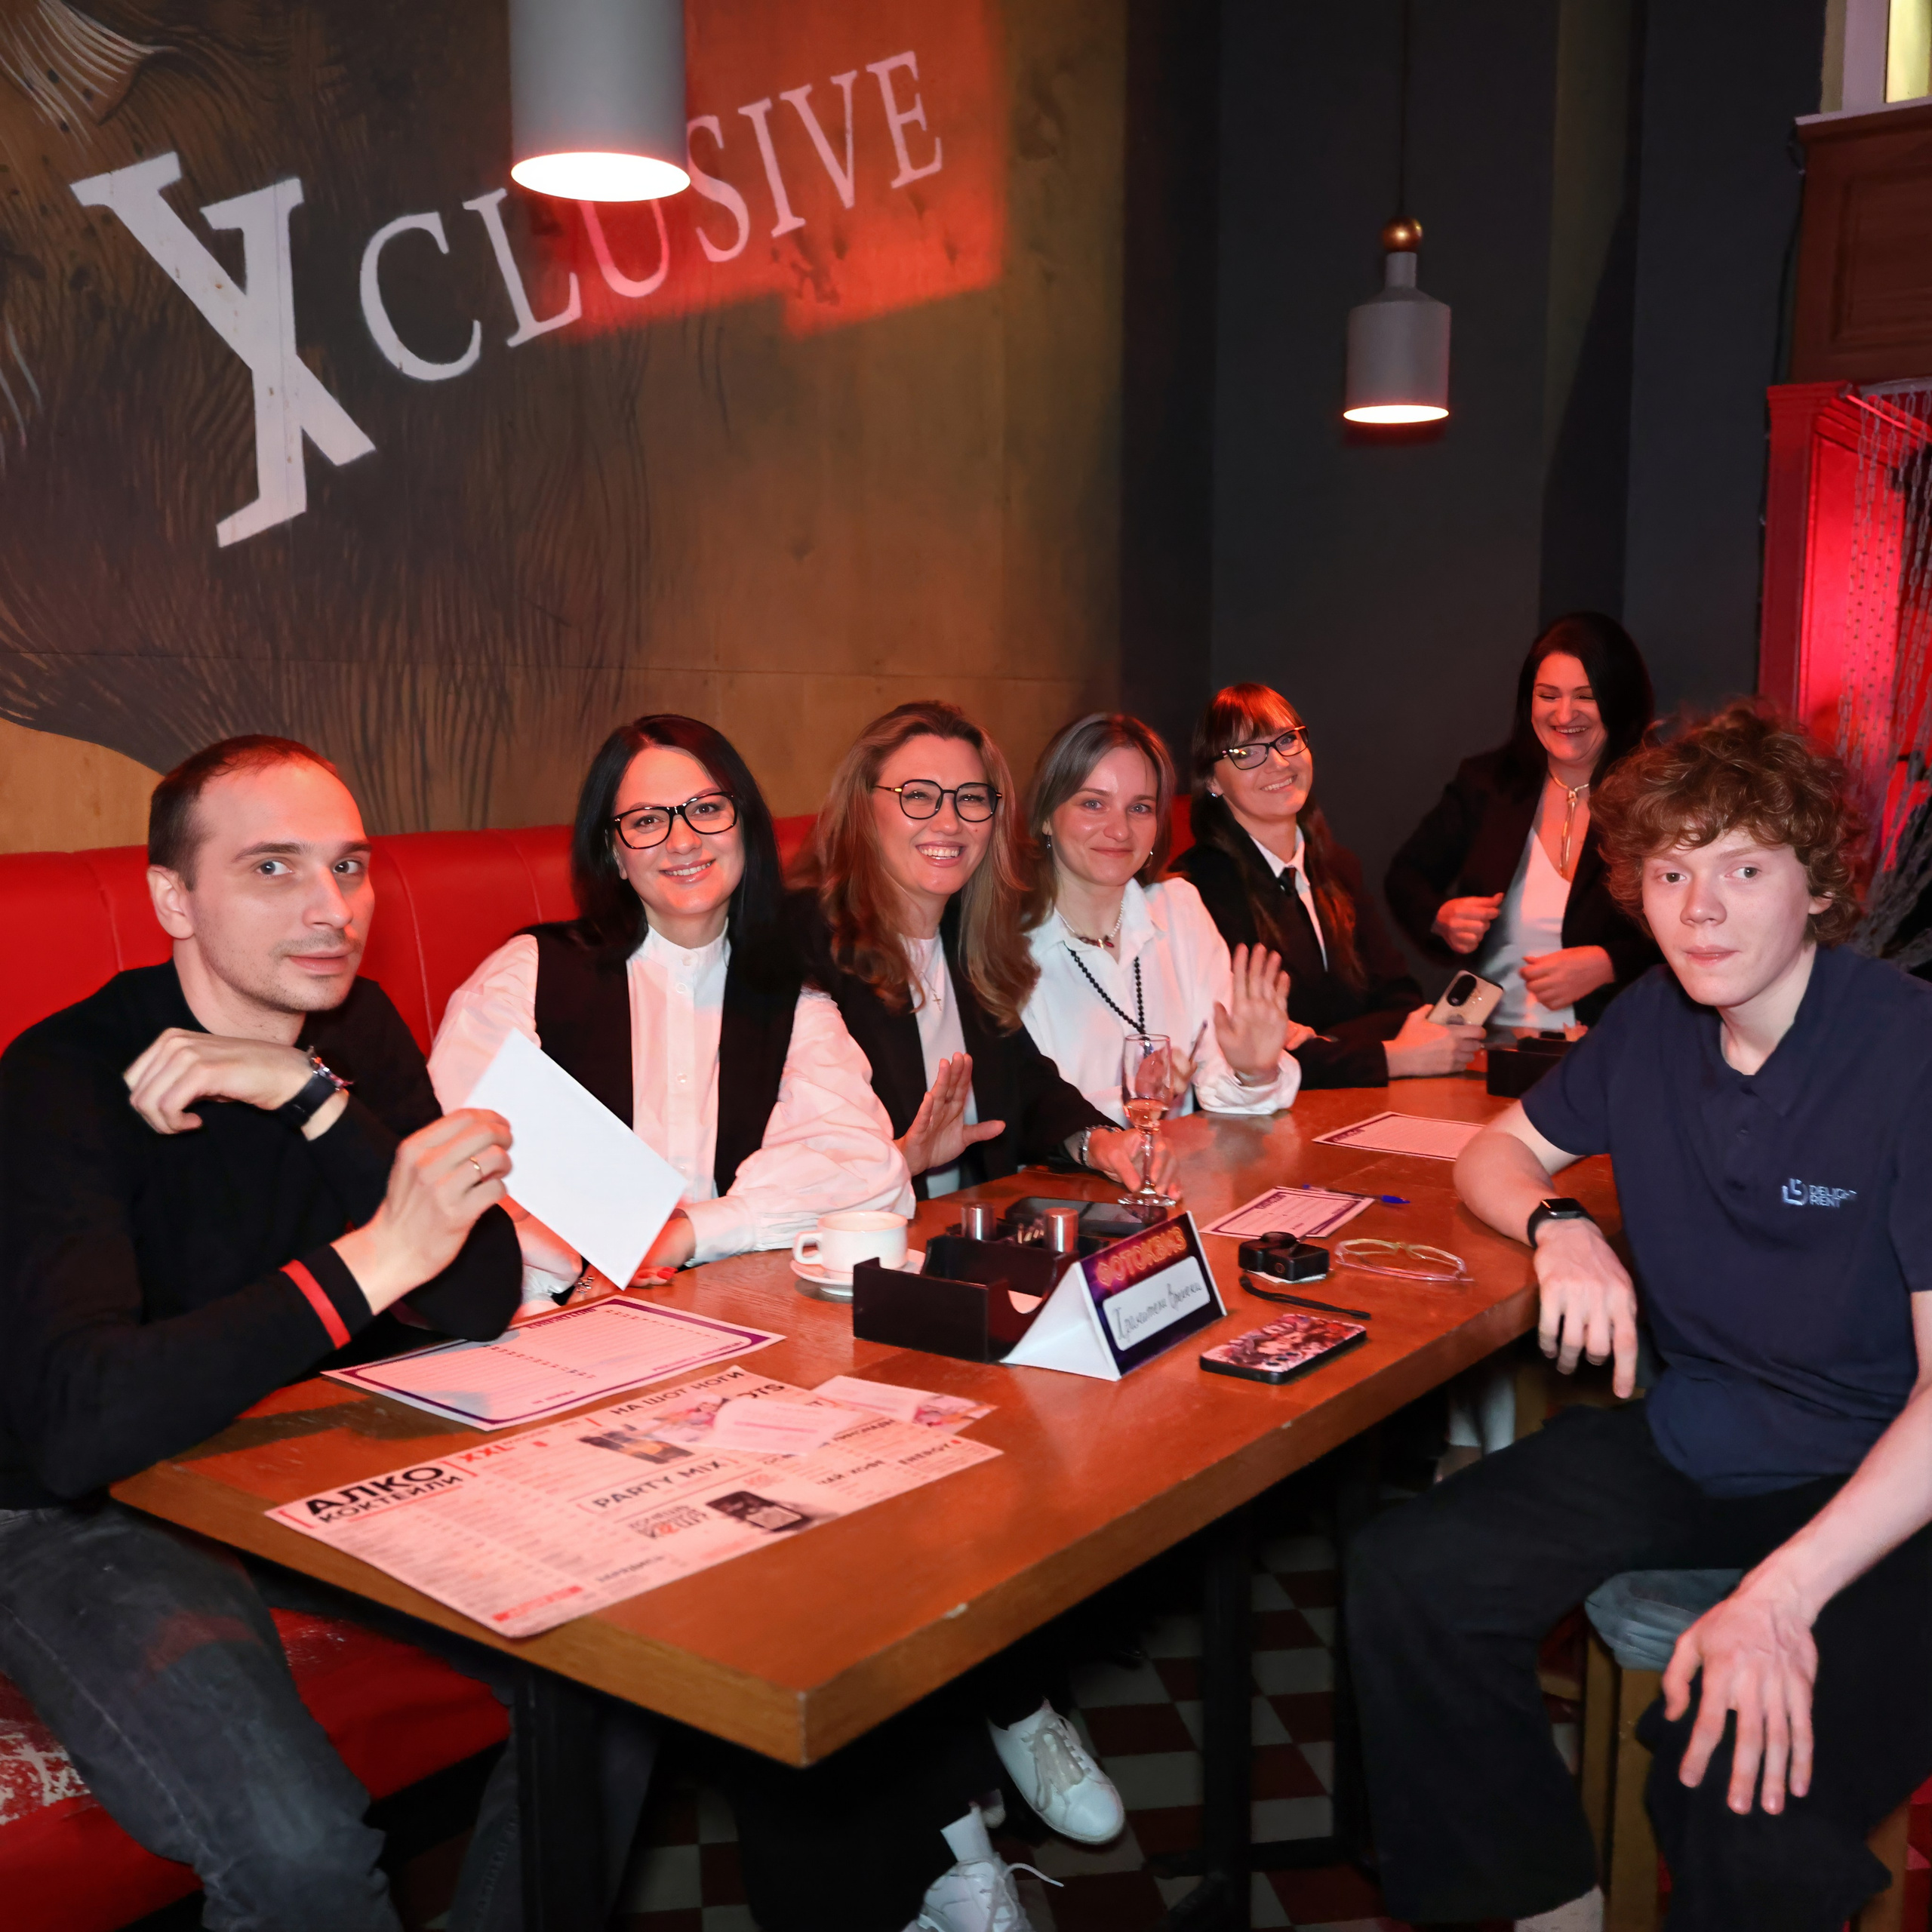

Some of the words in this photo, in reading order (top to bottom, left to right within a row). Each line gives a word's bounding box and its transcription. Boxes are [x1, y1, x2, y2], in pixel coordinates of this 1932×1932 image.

[1808, 1195, 1841, 1208] RENT
[610, 1403, 643, 1416] НА
[642, 1388, 687, 1406] ШОТ
[690, 1371, 745, 1391] НОГИ
[457, 1444, 515, 1463] XXL
[306, 1466, 444, 1516] АЛКО
[592, 1475, 674, 1508] PARTY
[677, 1460, 727, 1478] MIX
